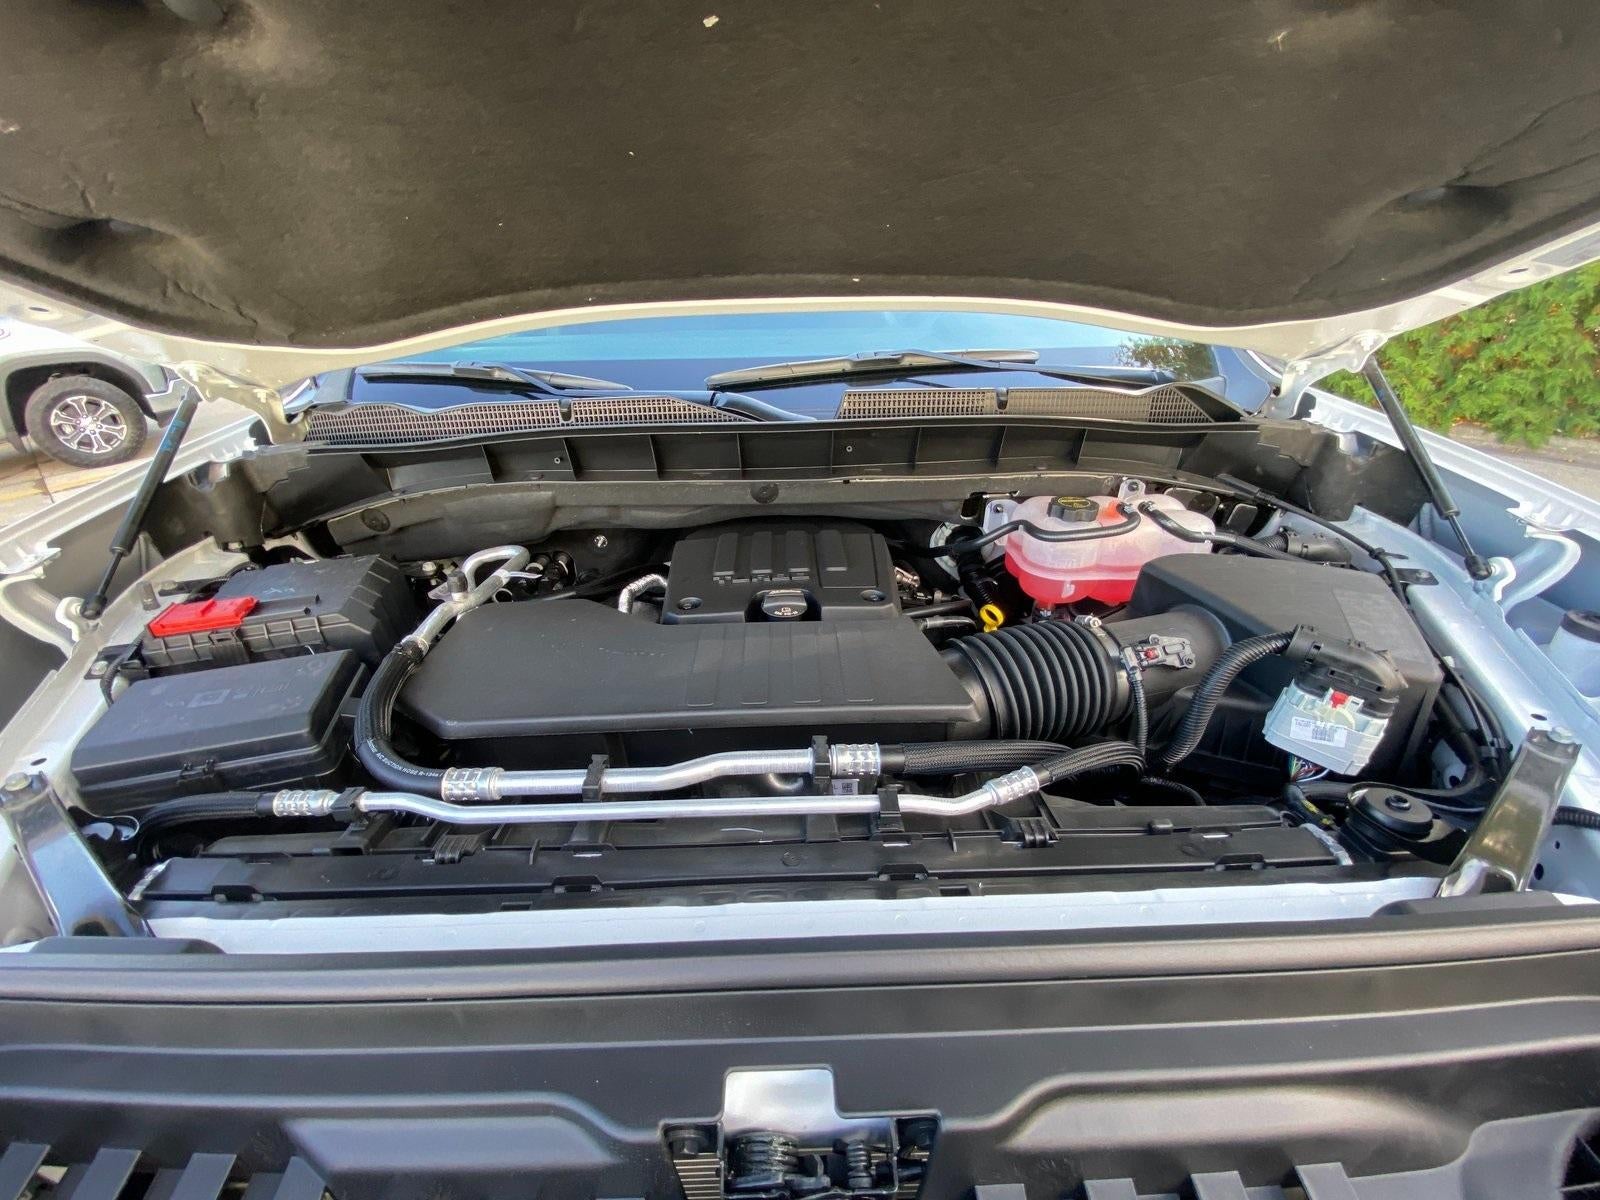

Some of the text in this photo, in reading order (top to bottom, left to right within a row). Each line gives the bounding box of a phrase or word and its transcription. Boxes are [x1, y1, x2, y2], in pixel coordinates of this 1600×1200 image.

[376, 752, 385, 760] AC
[382, 756, 402, 771] SUCTION
[402, 767, 419, 775] HOSE
